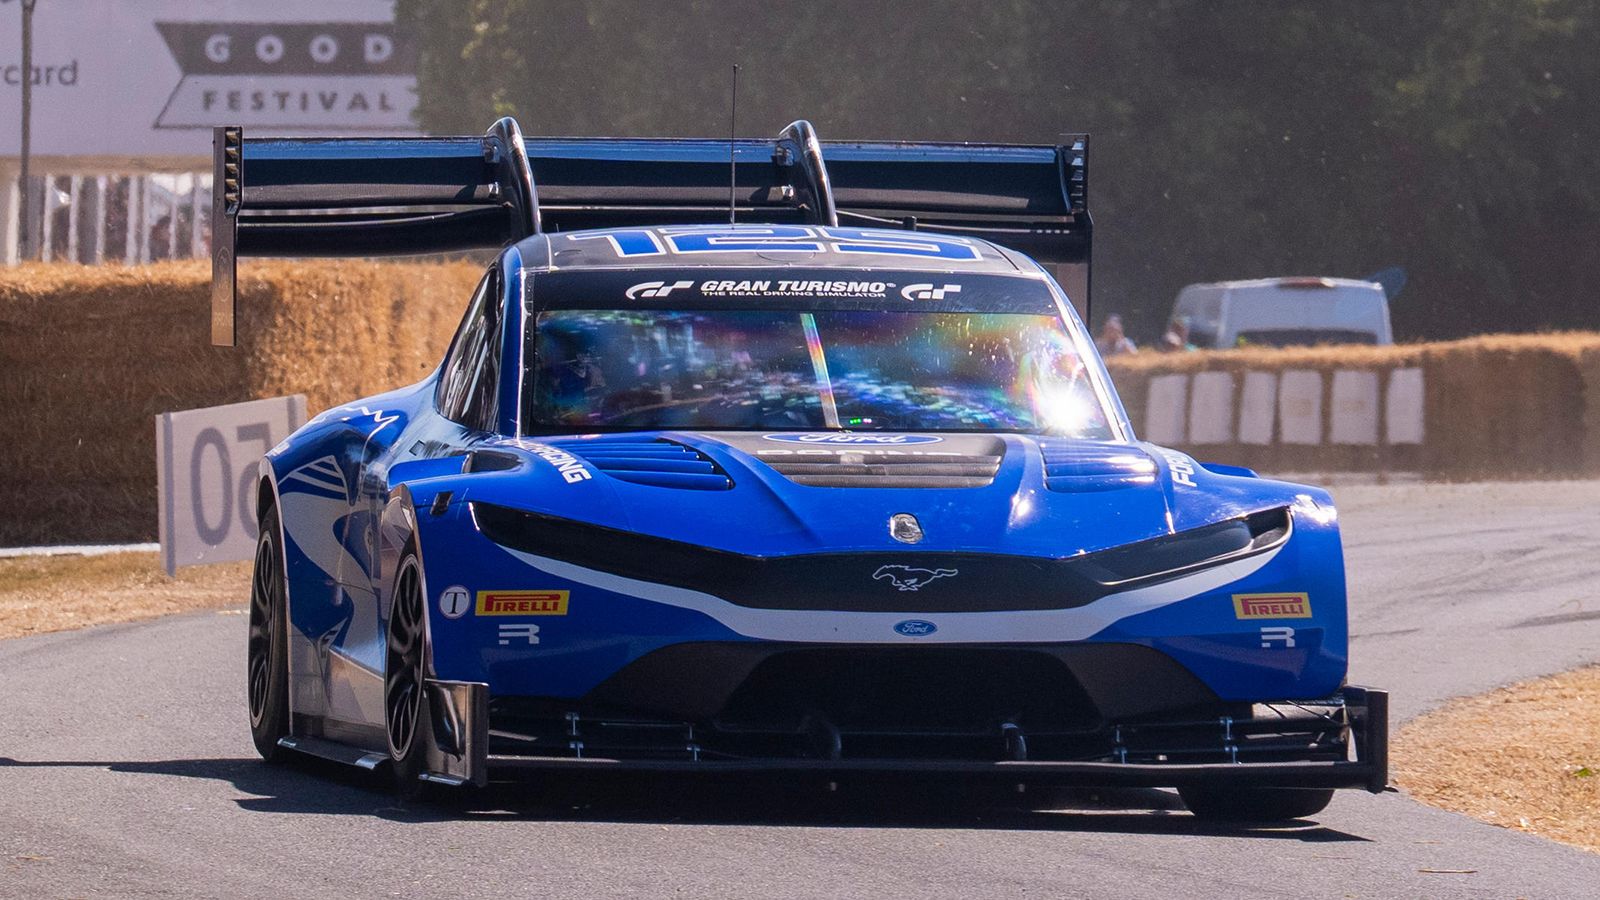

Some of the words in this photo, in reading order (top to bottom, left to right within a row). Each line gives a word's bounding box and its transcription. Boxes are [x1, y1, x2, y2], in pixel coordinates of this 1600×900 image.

[204, 33, 394, 64] GOOD
[202, 90, 394, 112] FESTIVAL
[566, 224, 984, 261] 125
[700, 280, 771, 292] GRAN
[445, 591, 467, 615] T
[484, 594, 561, 612] PIRELLI
[1240, 596, 1305, 615] PIRELLI
